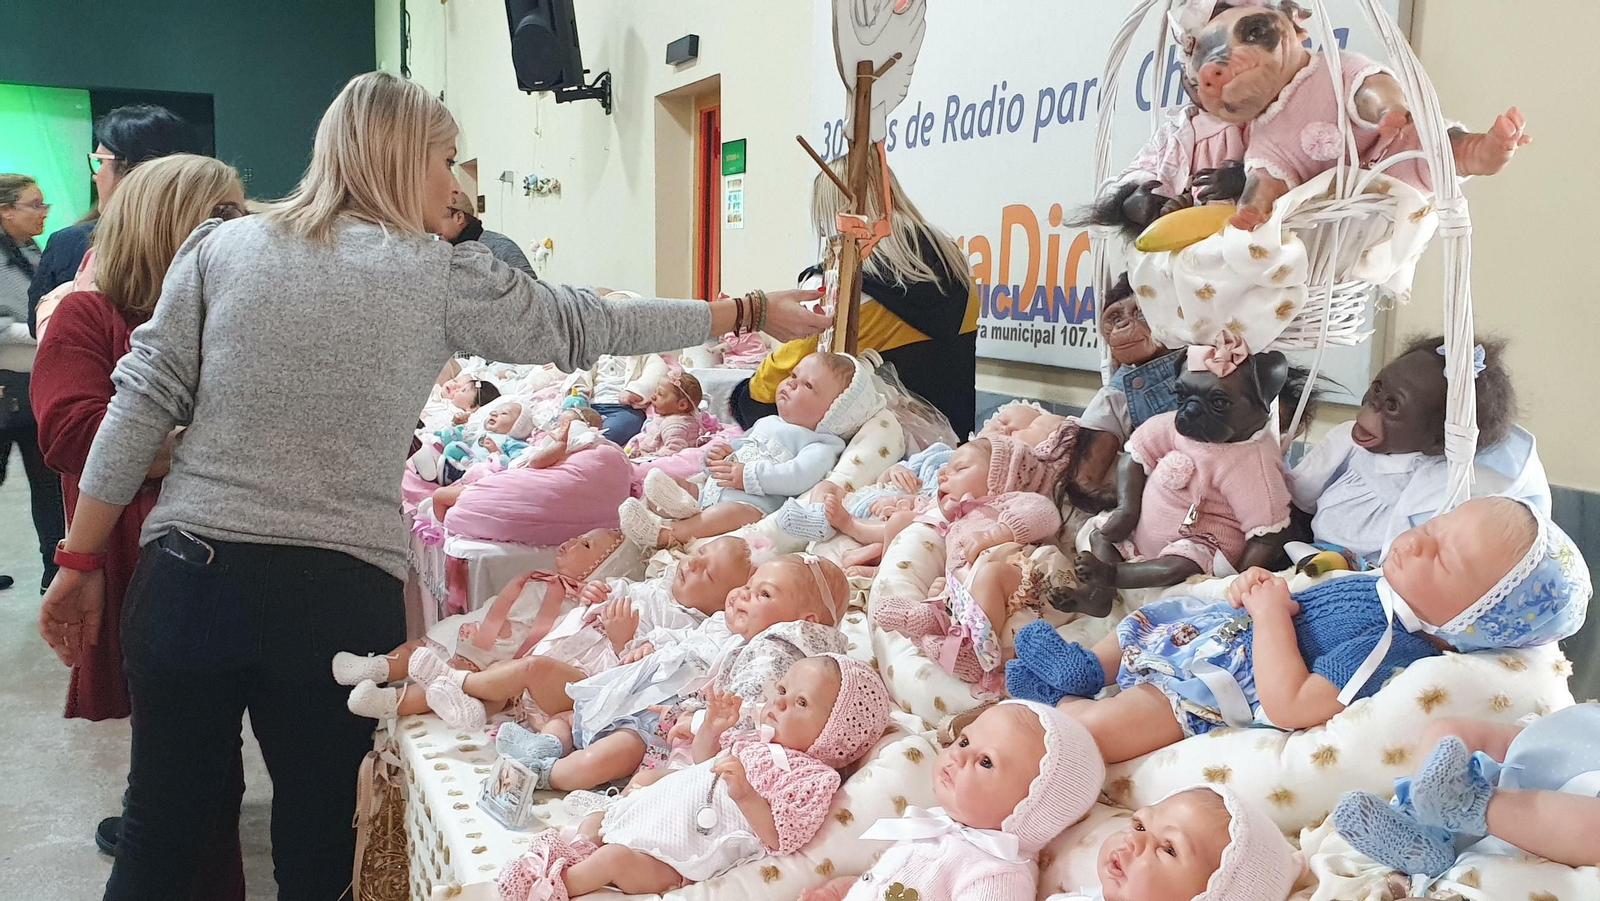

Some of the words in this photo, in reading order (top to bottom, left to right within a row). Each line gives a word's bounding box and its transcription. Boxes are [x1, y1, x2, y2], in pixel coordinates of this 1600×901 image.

[821, 118, 844, 161] 30
[905, 100, 935, 149] de
[942, 80, 1025, 143] Radio
[1033, 77, 1115, 143] par
[977, 284, 1096, 325] ICLANA
[991, 322, 1056, 348] municipal
